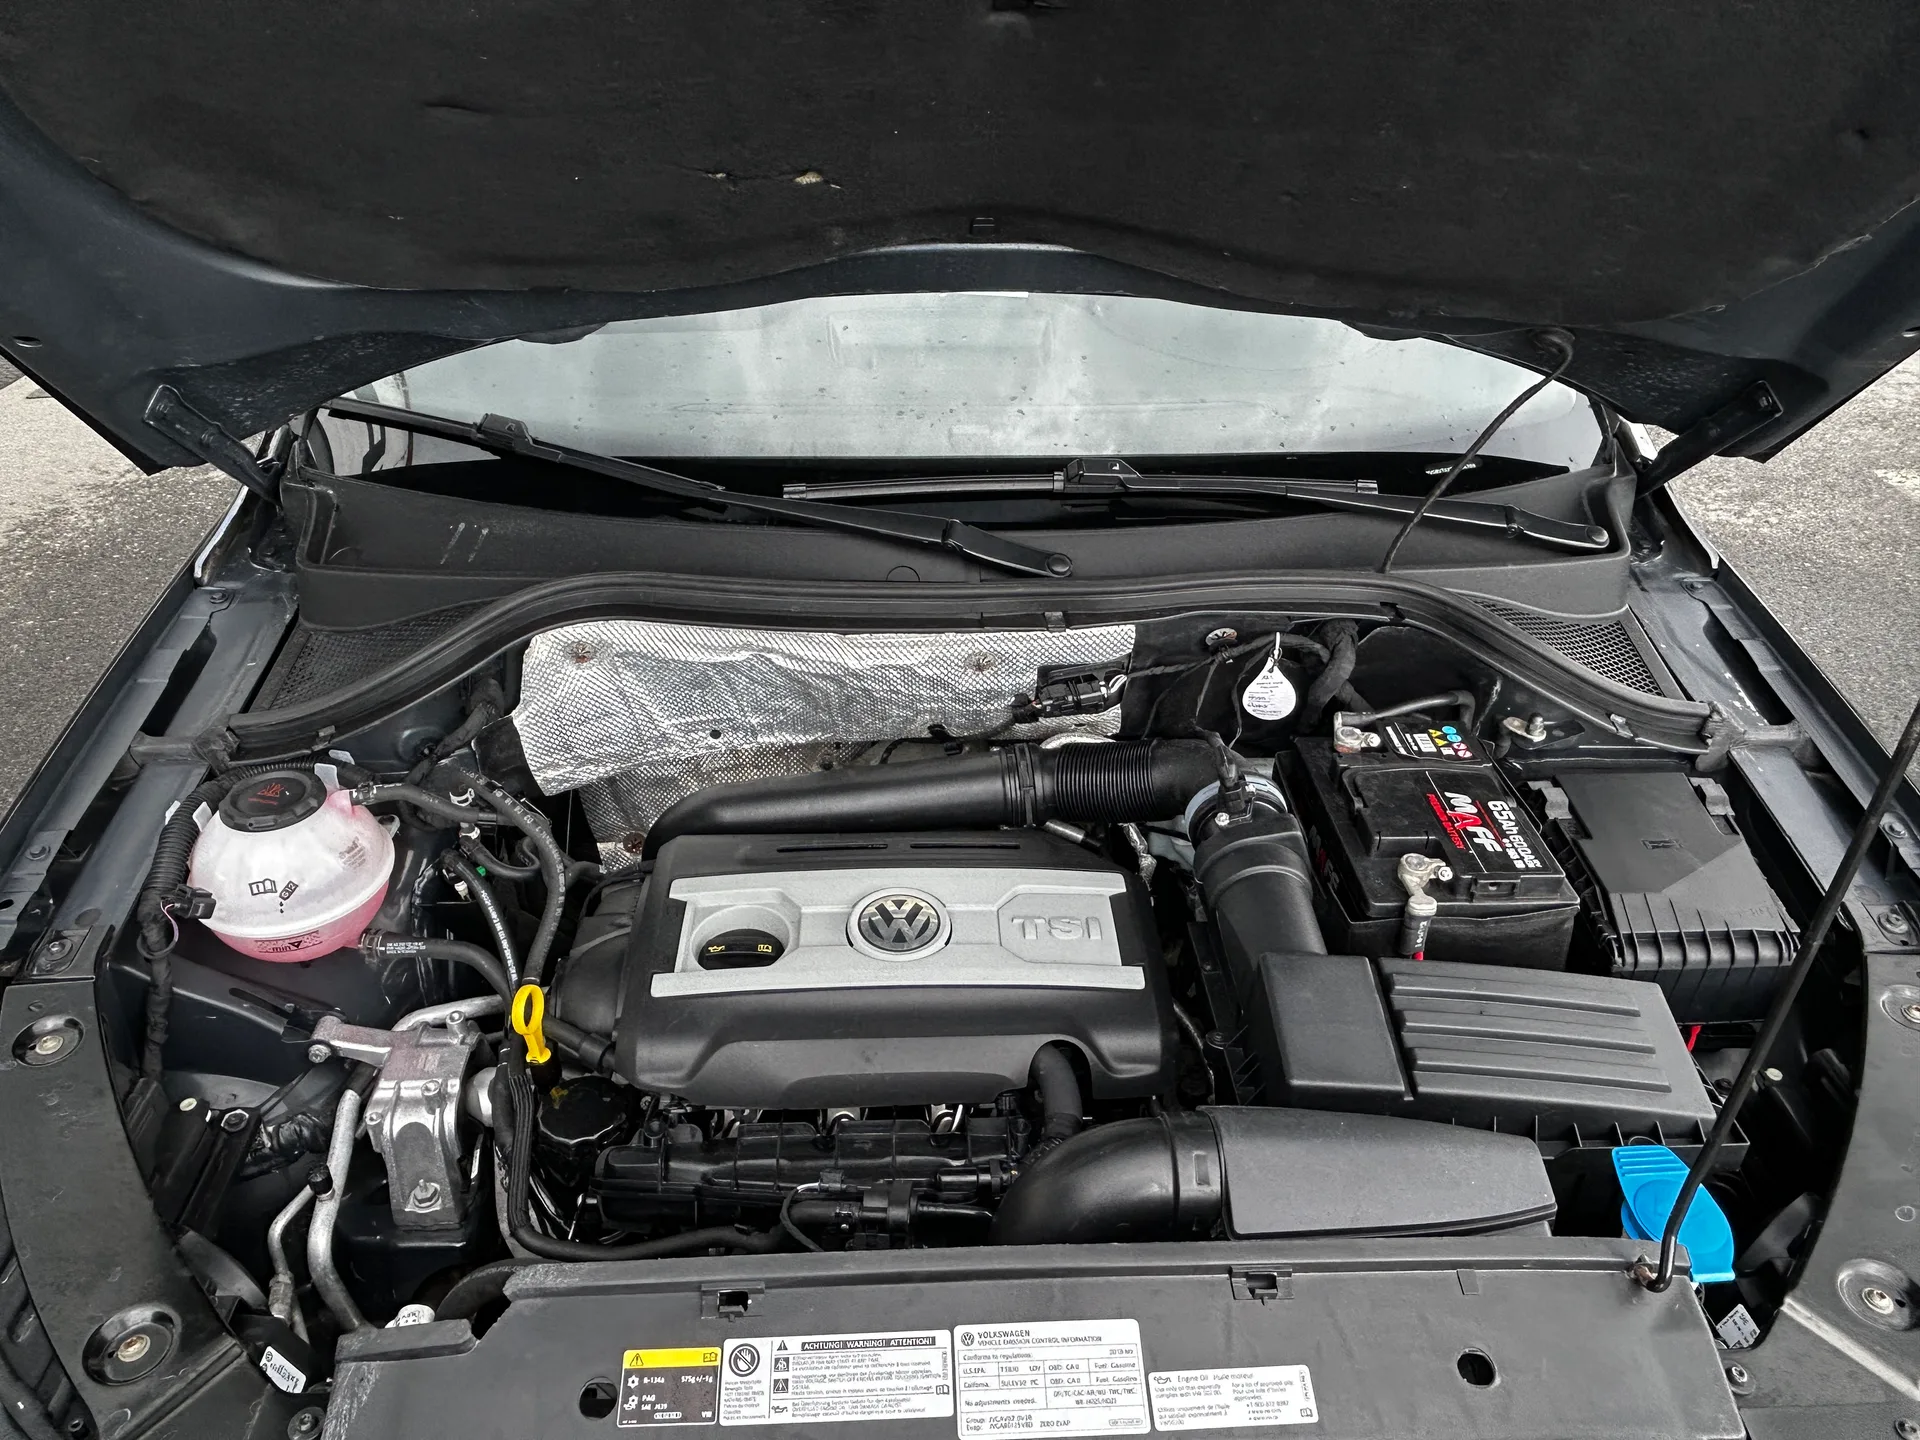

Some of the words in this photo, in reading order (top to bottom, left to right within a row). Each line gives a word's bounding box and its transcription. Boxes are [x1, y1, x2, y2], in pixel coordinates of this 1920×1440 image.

[1444, 791, 1503, 852] MAFF
[1011, 916, 1102, 941] TSI
[272, 943, 292, 952] min
[977, 1329, 1031, 1339] VOLKSWAGEN
[847, 1339, 886, 1348] WARNING!
[889, 1337, 933, 1346] ATTENTION!
[1177, 1374, 1199, 1383] Engine
